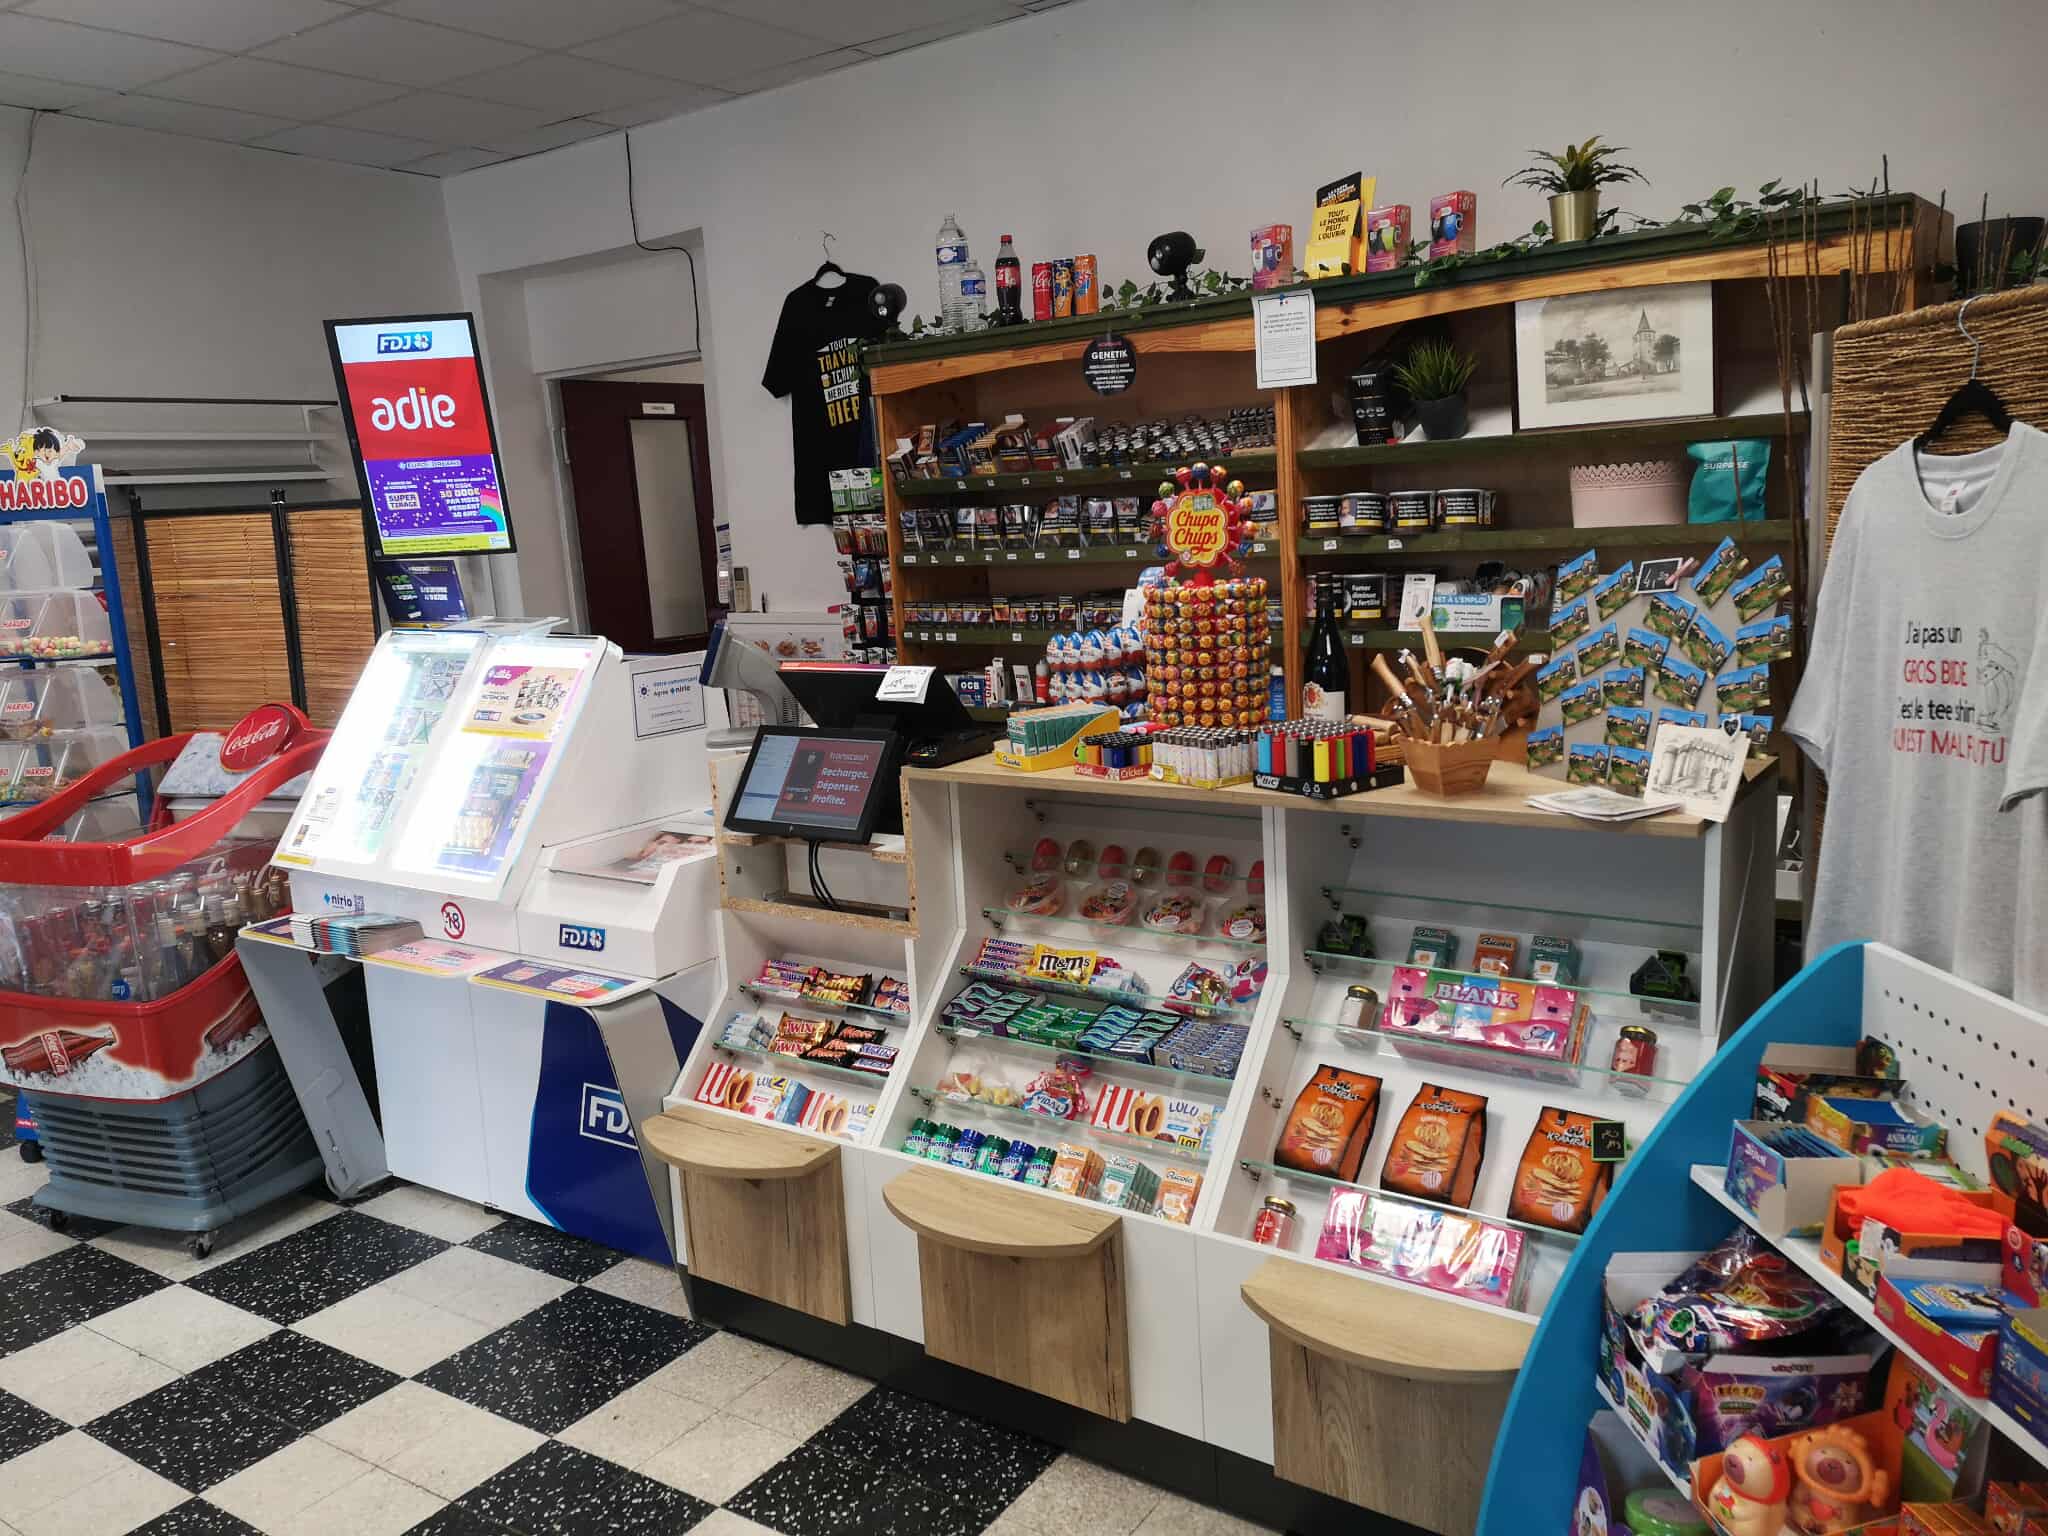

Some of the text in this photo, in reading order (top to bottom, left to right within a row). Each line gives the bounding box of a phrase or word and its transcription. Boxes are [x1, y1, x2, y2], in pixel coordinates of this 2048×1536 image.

[380, 336, 411, 352] FDJ
[372, 387, 456, 431] adie
[0, 478, 86, 509] HARIBO
[1176, 511, 1219, 530] Chupa
[1174, 528, 1217, 548] Chups
[1922, 627, 1945, 648] pas
[1928, 699, 1953, 720] tee
[561, 927, 588, 947] FDJ
[1436, 982, 1518, 1009] BLANK
[786, 1022, 814, 1034] TWIX
[775, 1040, 804, 1053] TWIX
[1168, 1101, 1200, 1117] LULU
